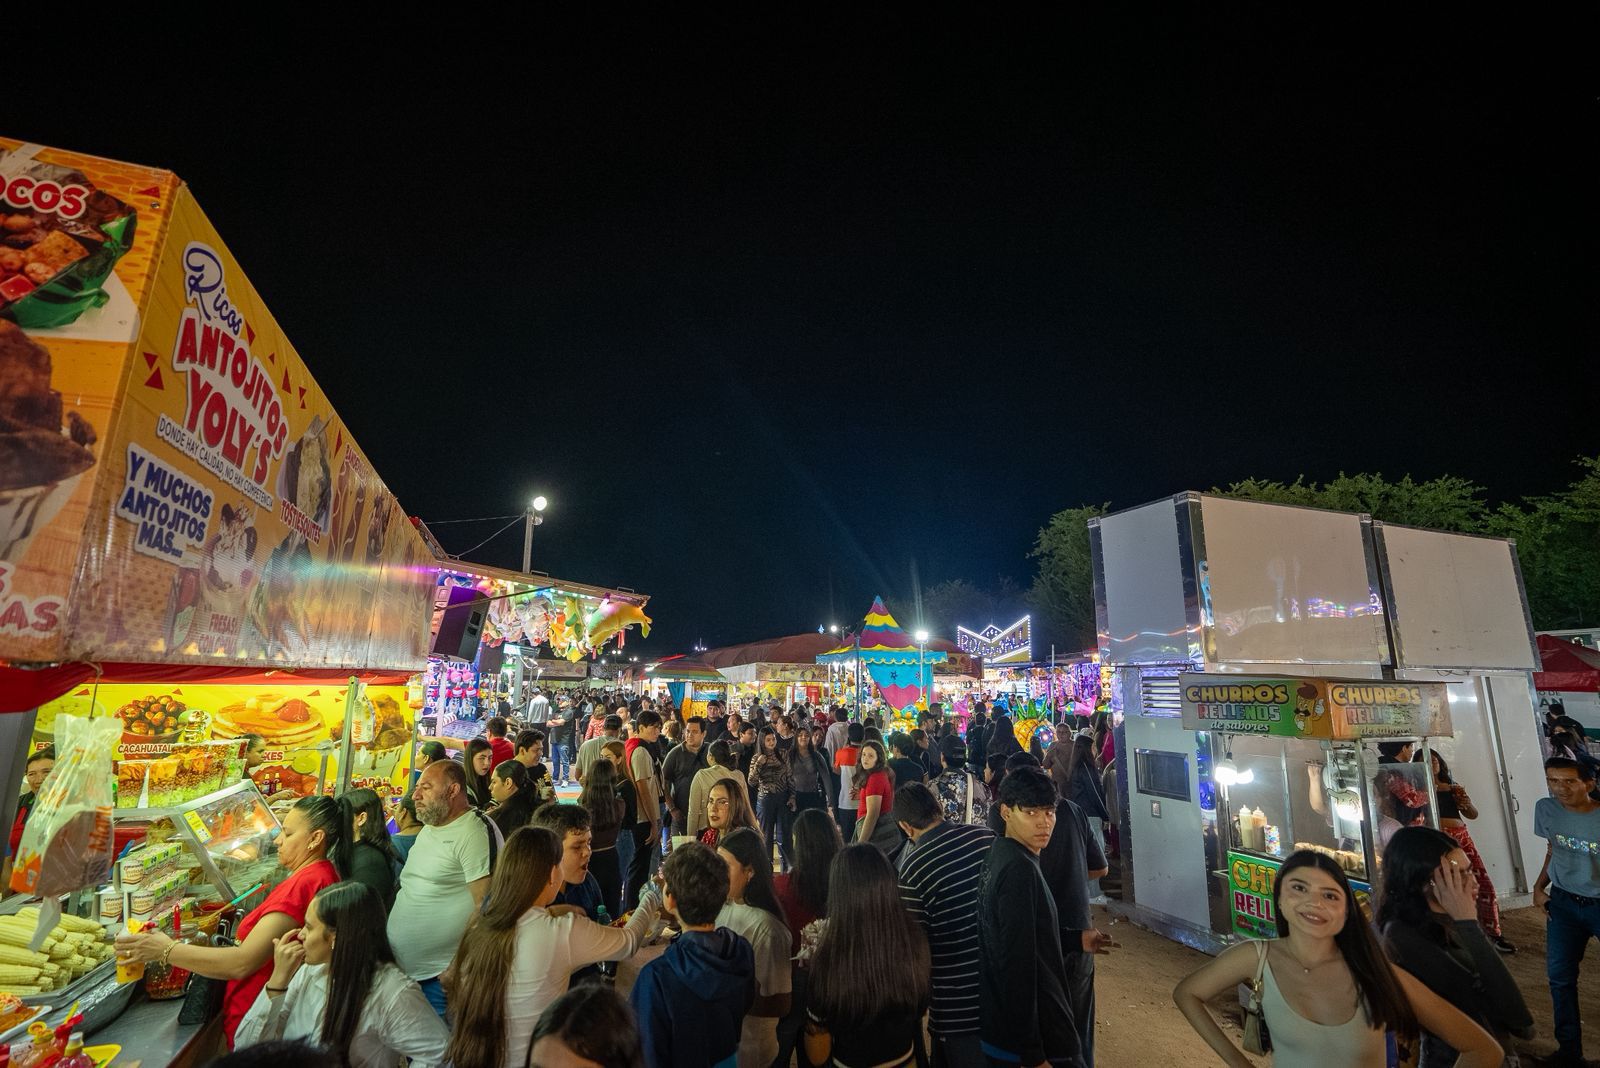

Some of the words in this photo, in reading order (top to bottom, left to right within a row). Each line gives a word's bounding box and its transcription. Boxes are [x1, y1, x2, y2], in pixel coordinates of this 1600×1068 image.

[0, 174, 86, 217] COS
[186, 248, 242, 335] Ricos
[176, 317, 287, 454] ANTOJITOS
[159, 419, 185, 447] DONDE
[186, 438, 200, 456] HAY
[225, 464, 233, 480] NO
[187, 367, 272, 485] YOLY'S
[130, 450, 145, 482] Y
[144, 462, 212, 519] MUCHOS
[121, 486, 206, 542] ANTOJITOS
[1186, 684, 1289, 703] CHURROS
[1198, 704, 1281, 722] RELLENOS
[1332, 685, 1422, 706] CHURROS
[1210, 720, 1225, 730] de
[1225, 720, 1270, 732] sabores
